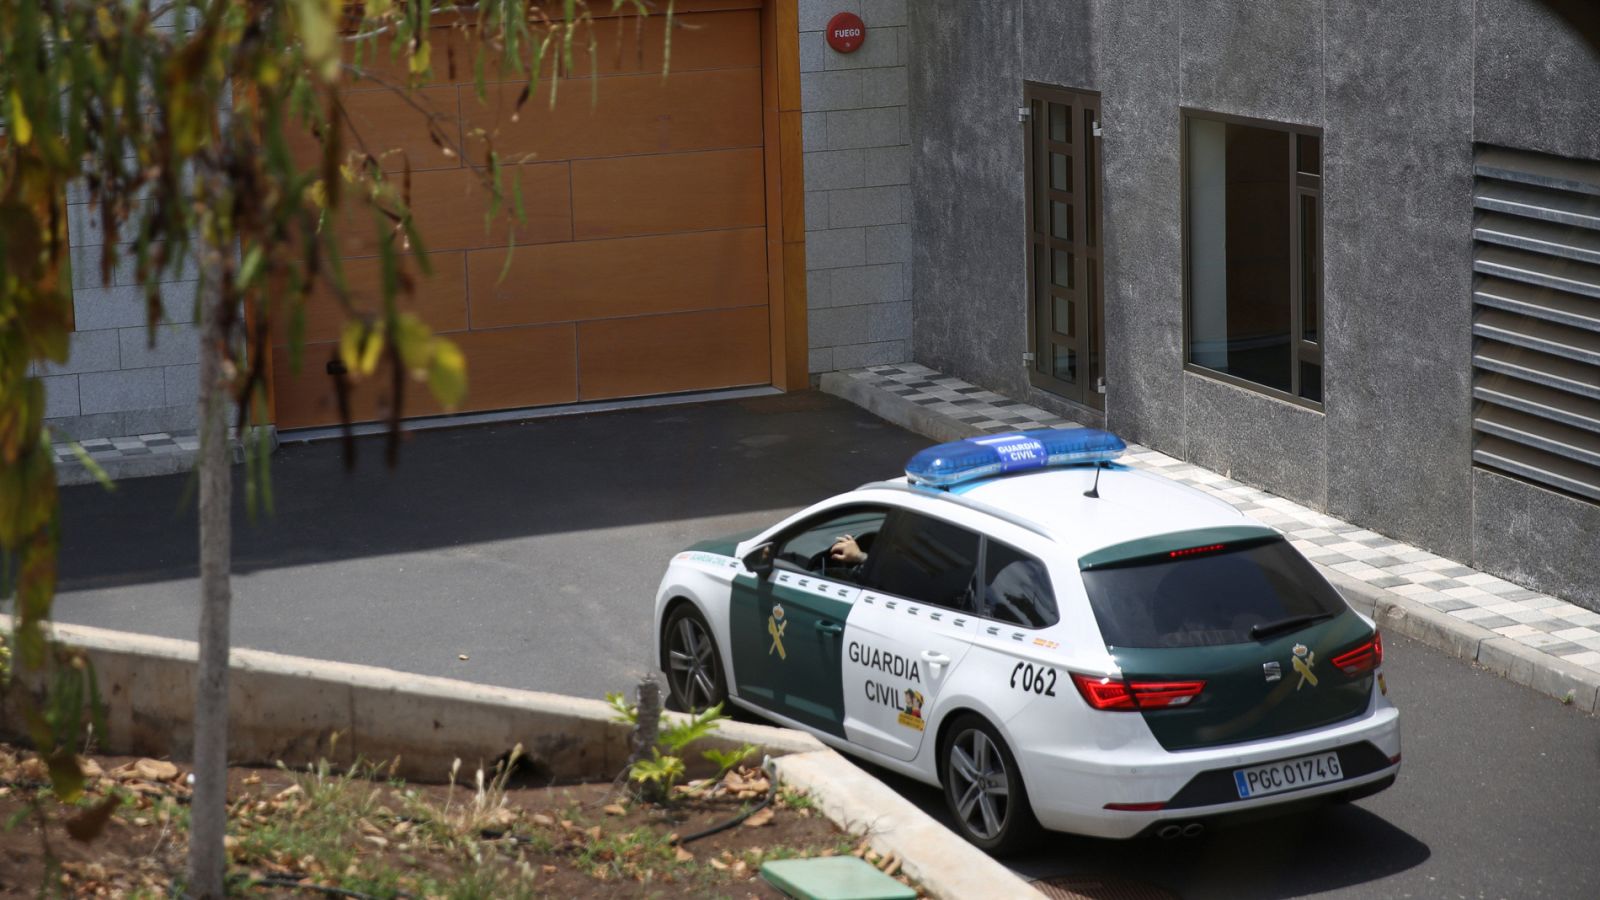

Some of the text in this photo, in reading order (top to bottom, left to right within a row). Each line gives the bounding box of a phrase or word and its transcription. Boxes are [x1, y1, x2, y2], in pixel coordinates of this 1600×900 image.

[834, 29, 860, 38] FUEGO
[998, 441, 1042, 454] GUARDIA
[1010, 450, 1036, 461] CIVIL
[849, 641, 921, 683] GUARDIA
[1022, 663, 1057, 697] 062
[865, 680, 905, 711] CIVIL
